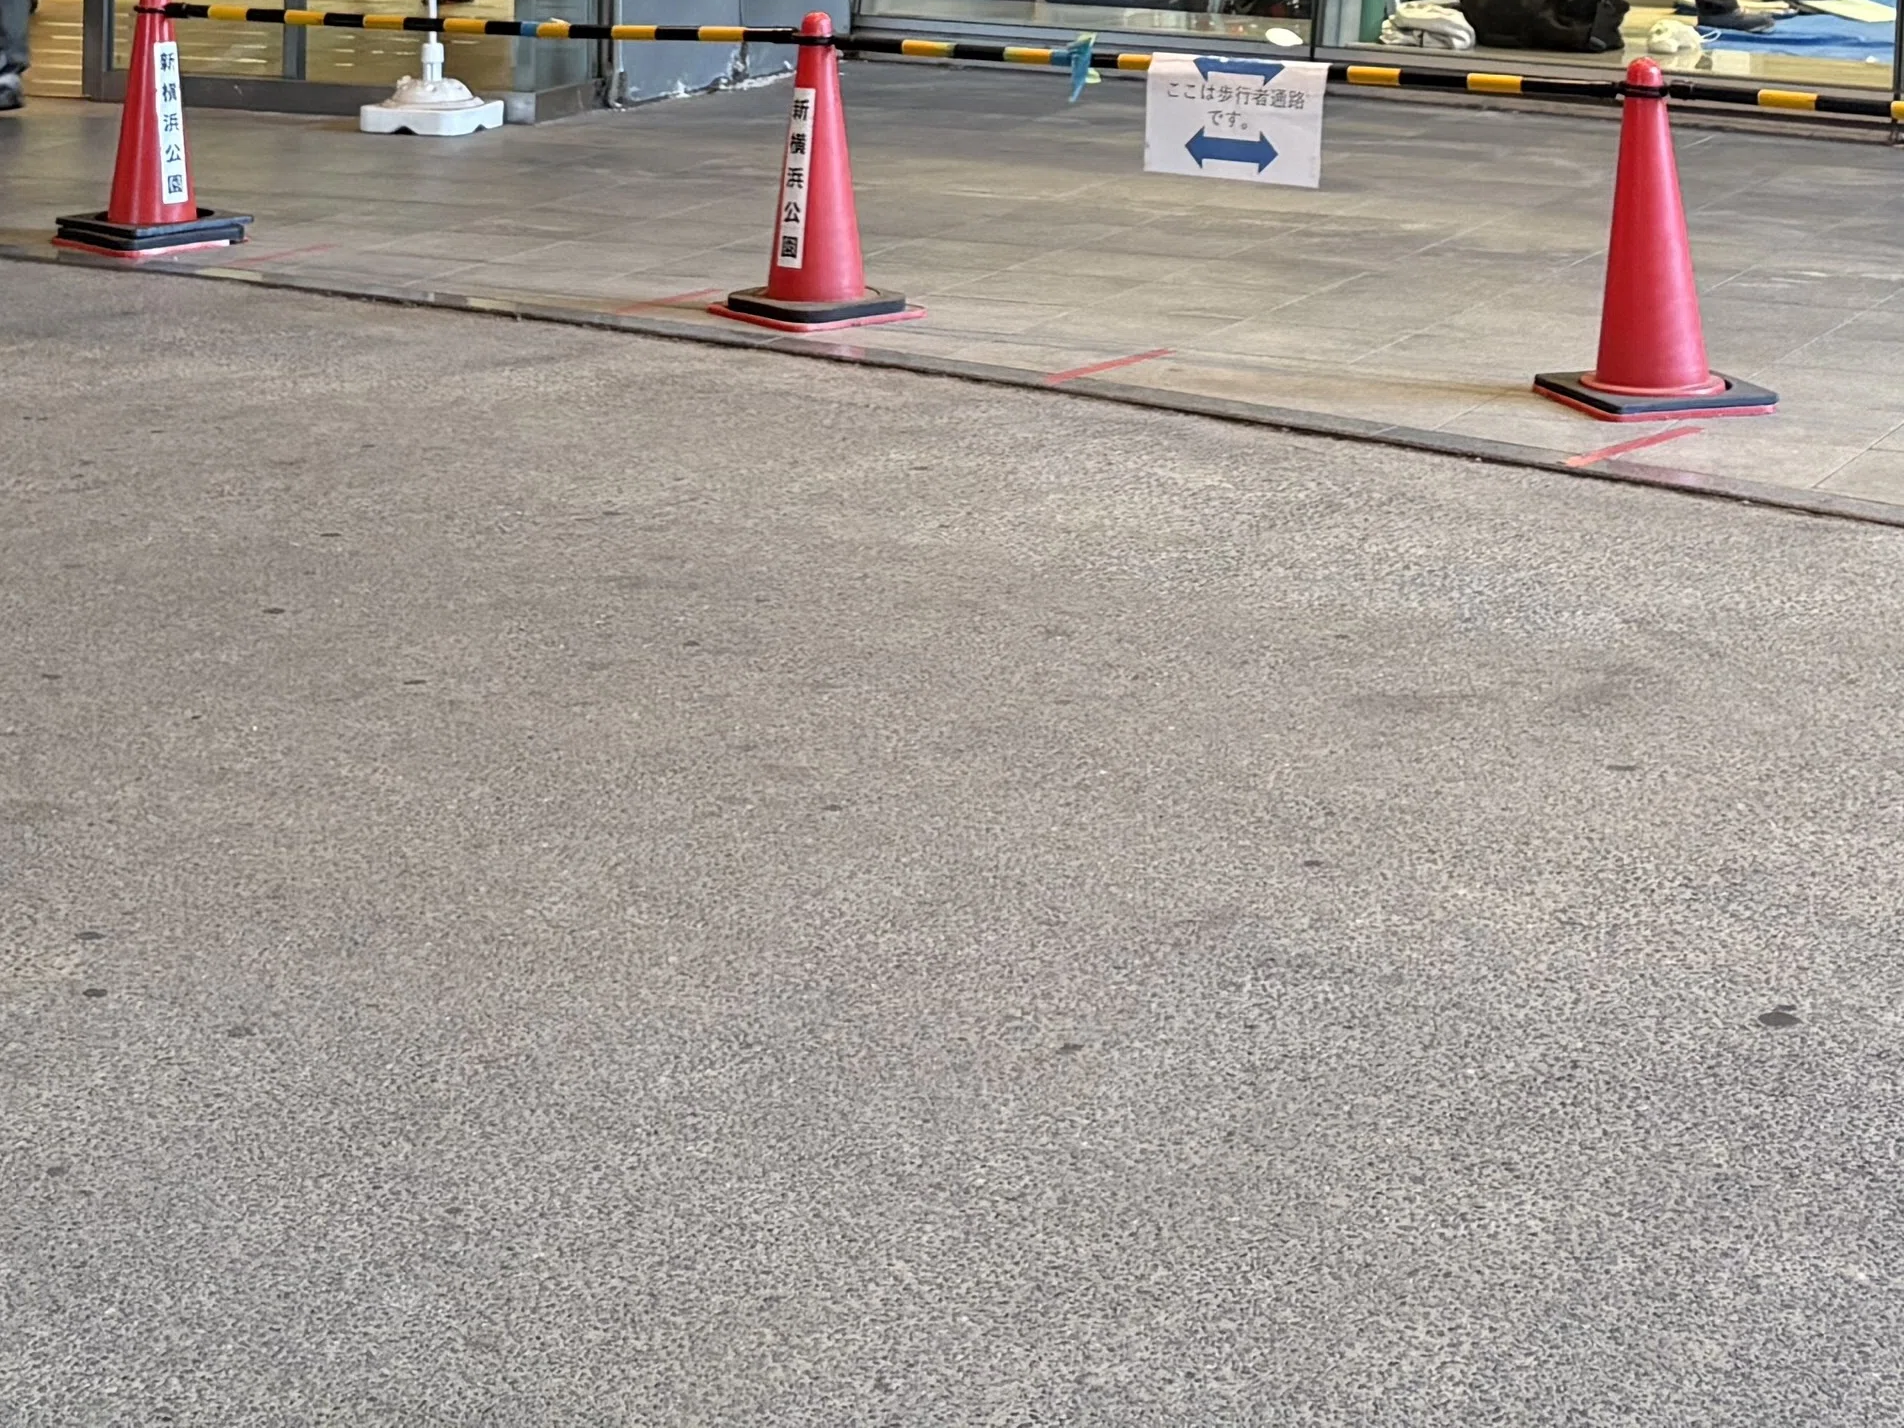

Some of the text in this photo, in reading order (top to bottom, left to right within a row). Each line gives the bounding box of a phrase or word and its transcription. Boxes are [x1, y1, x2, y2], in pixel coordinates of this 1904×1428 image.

[1166, 81, 1305, 110] ここは歩行者通路
[159, 51, 184, 194] 新横浜公園
[1207, 109, 1249, 130] です。
